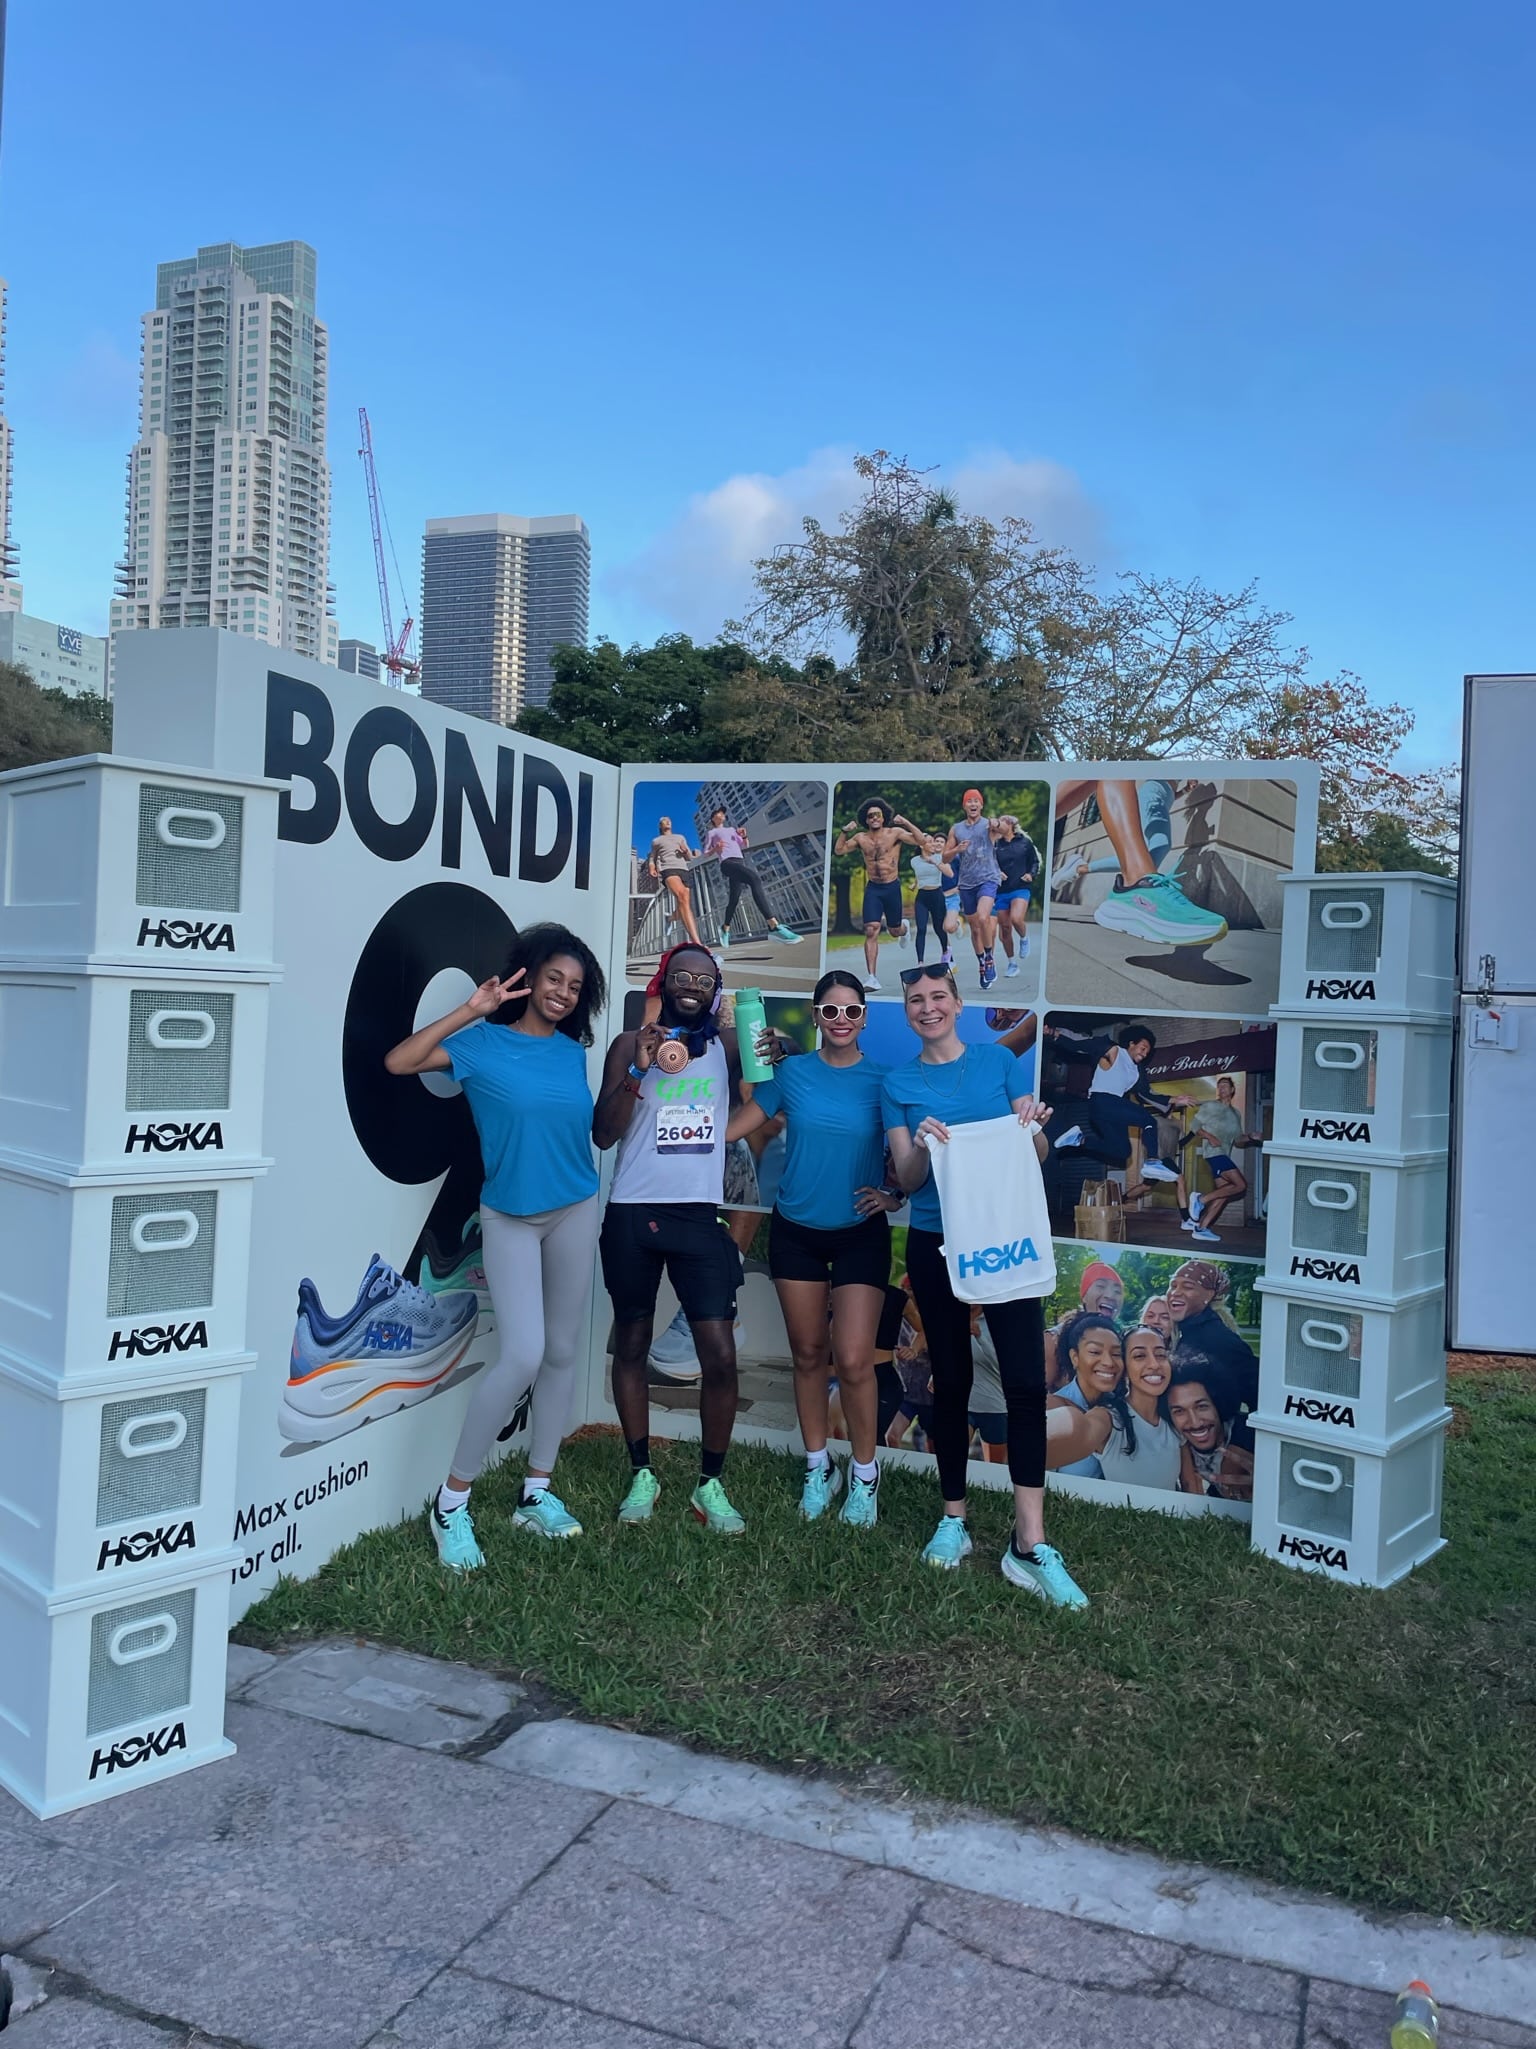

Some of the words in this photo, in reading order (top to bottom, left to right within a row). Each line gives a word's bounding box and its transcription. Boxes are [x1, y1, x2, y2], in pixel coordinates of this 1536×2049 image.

[60, 632, 83, 650] YVE
[264, 670, 593, 891] BONDI
[136, 918, 235, 952] HOKA
[1305, 979, 1376, 1001] HOKA
[749, 1020, 772, 1067] HKA
[1171, 1054, 1238, 1071] Bakery
[124, 1122, 224, 1154] HOKA
[657, 1125, 714, 1141] 26047
[1299, 1118, 1371, 1144] HOKA
[958, 1236, 1039, 1279] HOKA
[1289, 1255, 1361, 1285] HOKA
[107, 1320, 208, 1361] HOKA
[362, 1320, 413, 1350] HOKA
[1284, 1394, 1355, 1429] HOKA
[233, 1498, 287, 1541] Max
[294, 1460, 369, 1511] cushion
[96, 1520, 196, 1571] HOKA
[270, 1522, 302, 1563] all.
[1278, 1533, 1348, 1572] HOKA
[88, 1722, 187, 1780] HOKA
